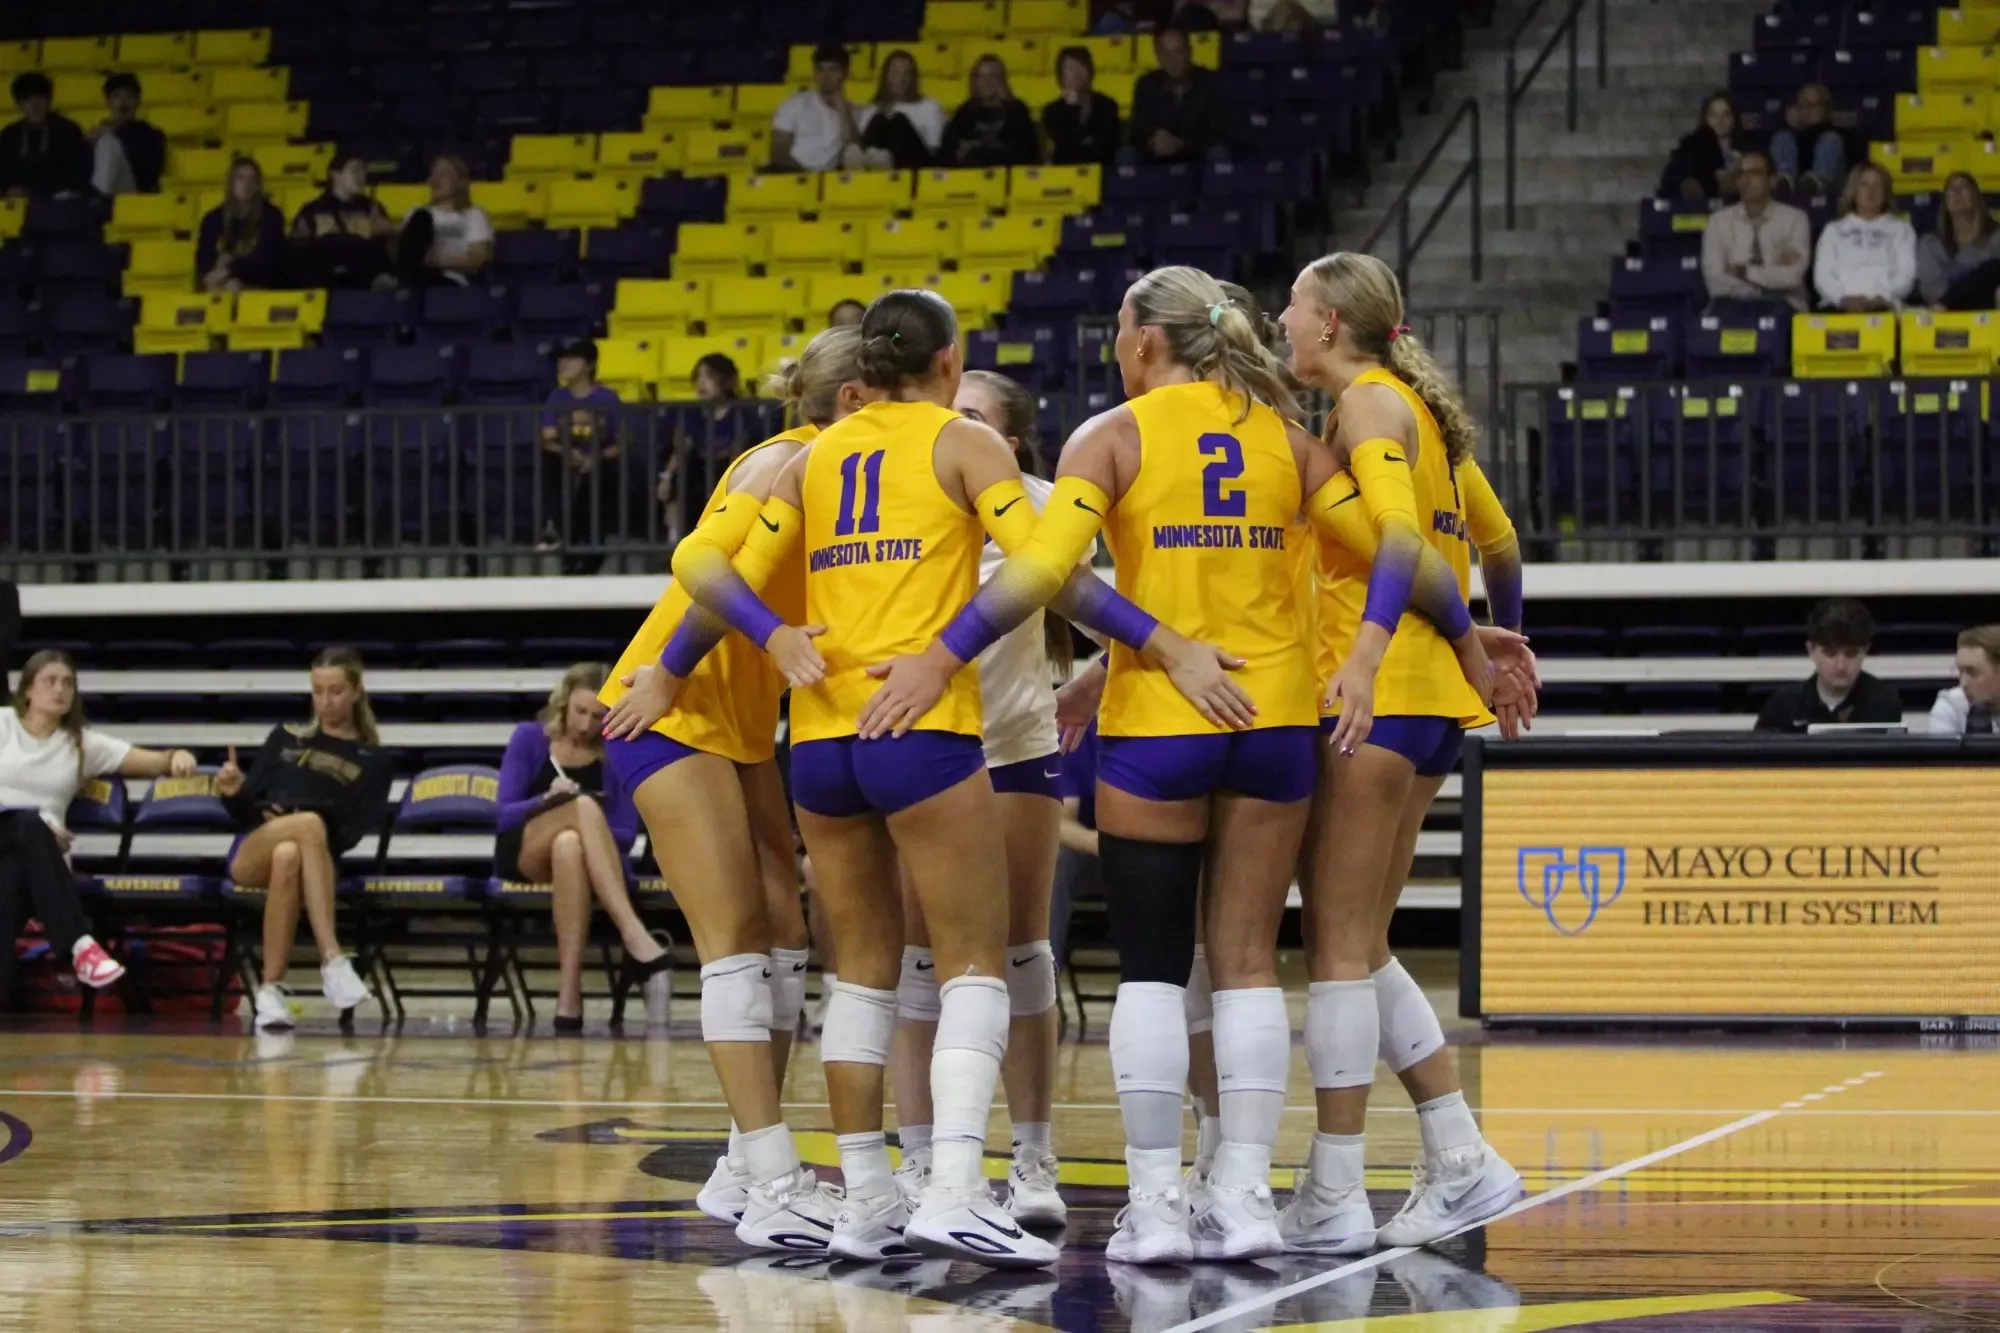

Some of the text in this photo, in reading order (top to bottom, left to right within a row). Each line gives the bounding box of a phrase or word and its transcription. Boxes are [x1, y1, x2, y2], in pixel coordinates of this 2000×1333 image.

[835, 449, 886, 536] 11
[1198, 433, 1246, 517] 2
[1153, 525, 1285, 550] MINNESOTA STATE
[809, 539, 922, 574] MINNESOTA STATE
[1643, 844, 1940, 879] MAYO CLINIC
[1643, 900, 1940, 925] HEALTH SYSTEM
